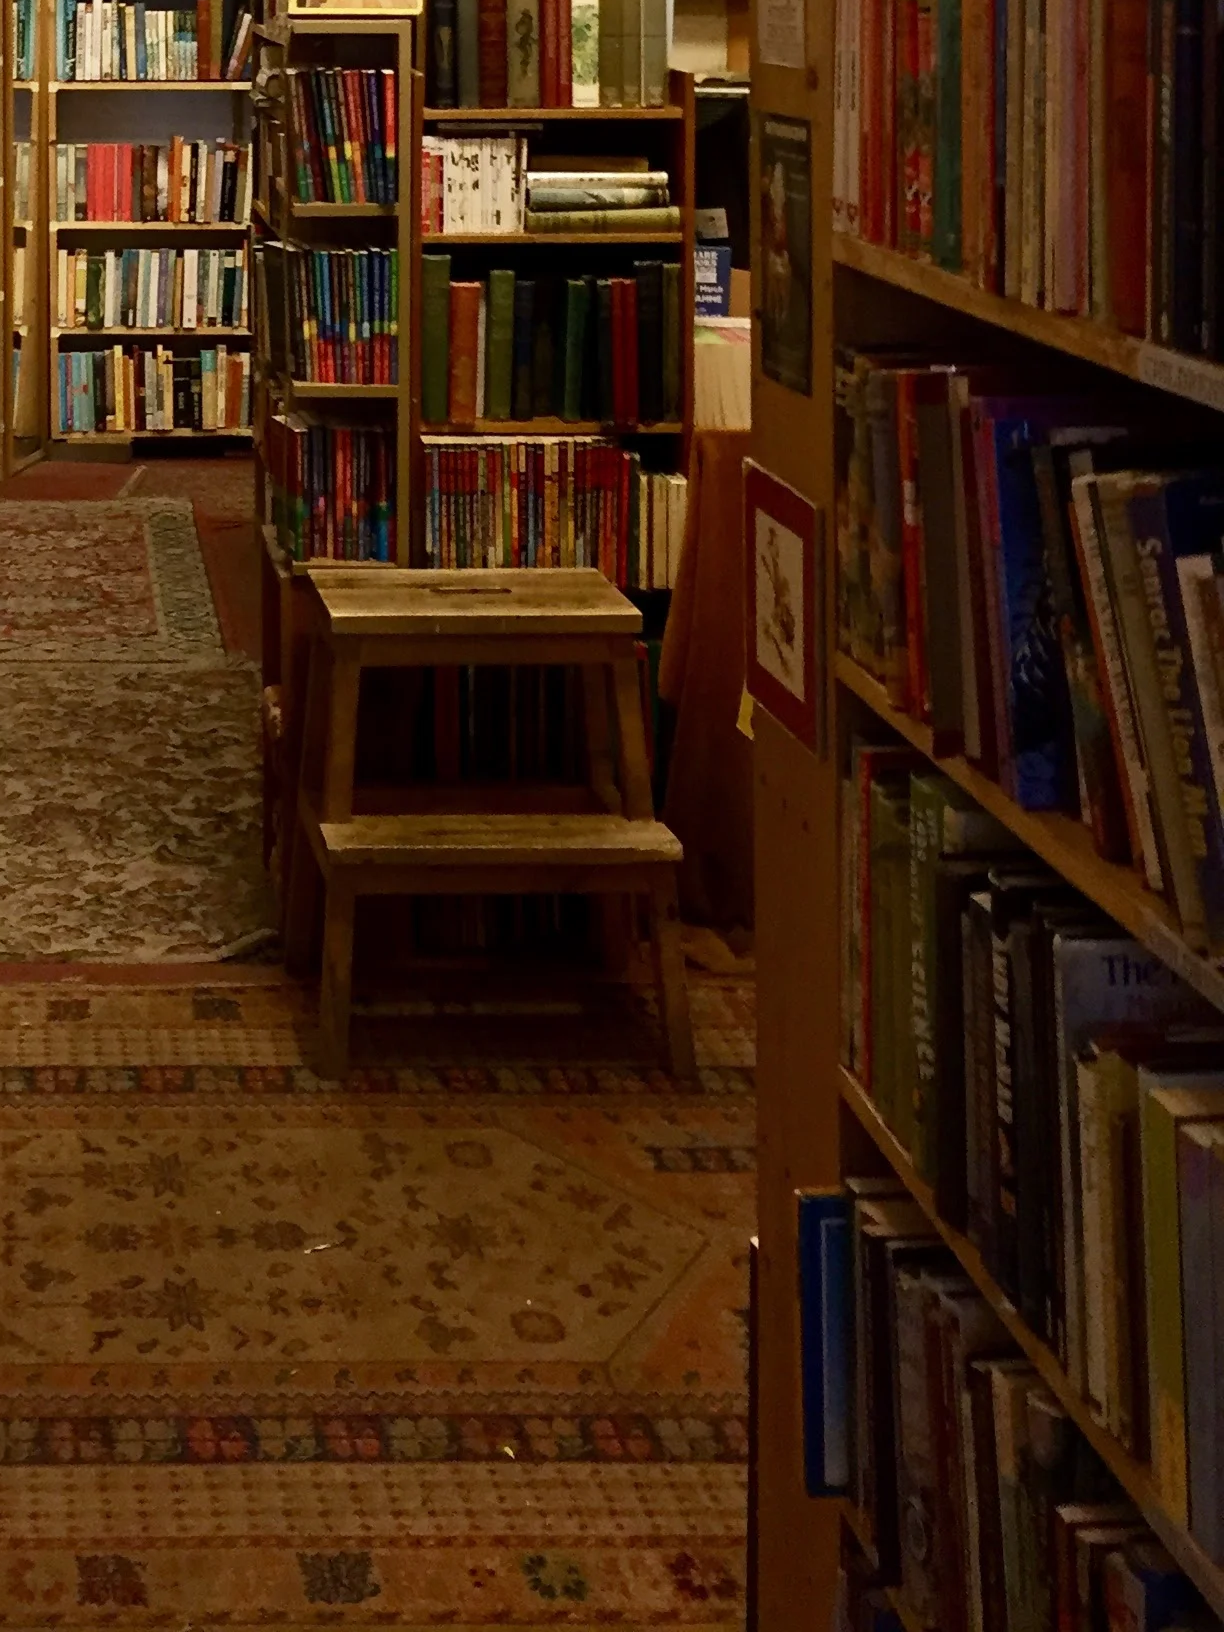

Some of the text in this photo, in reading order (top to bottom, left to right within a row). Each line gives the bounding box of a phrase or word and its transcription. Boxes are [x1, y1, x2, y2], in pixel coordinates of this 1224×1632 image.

[1155, 646, 1184, 701] The
[1166, 708, 1196, 776] Lion
[1180, 782, 1209, 859] Man
